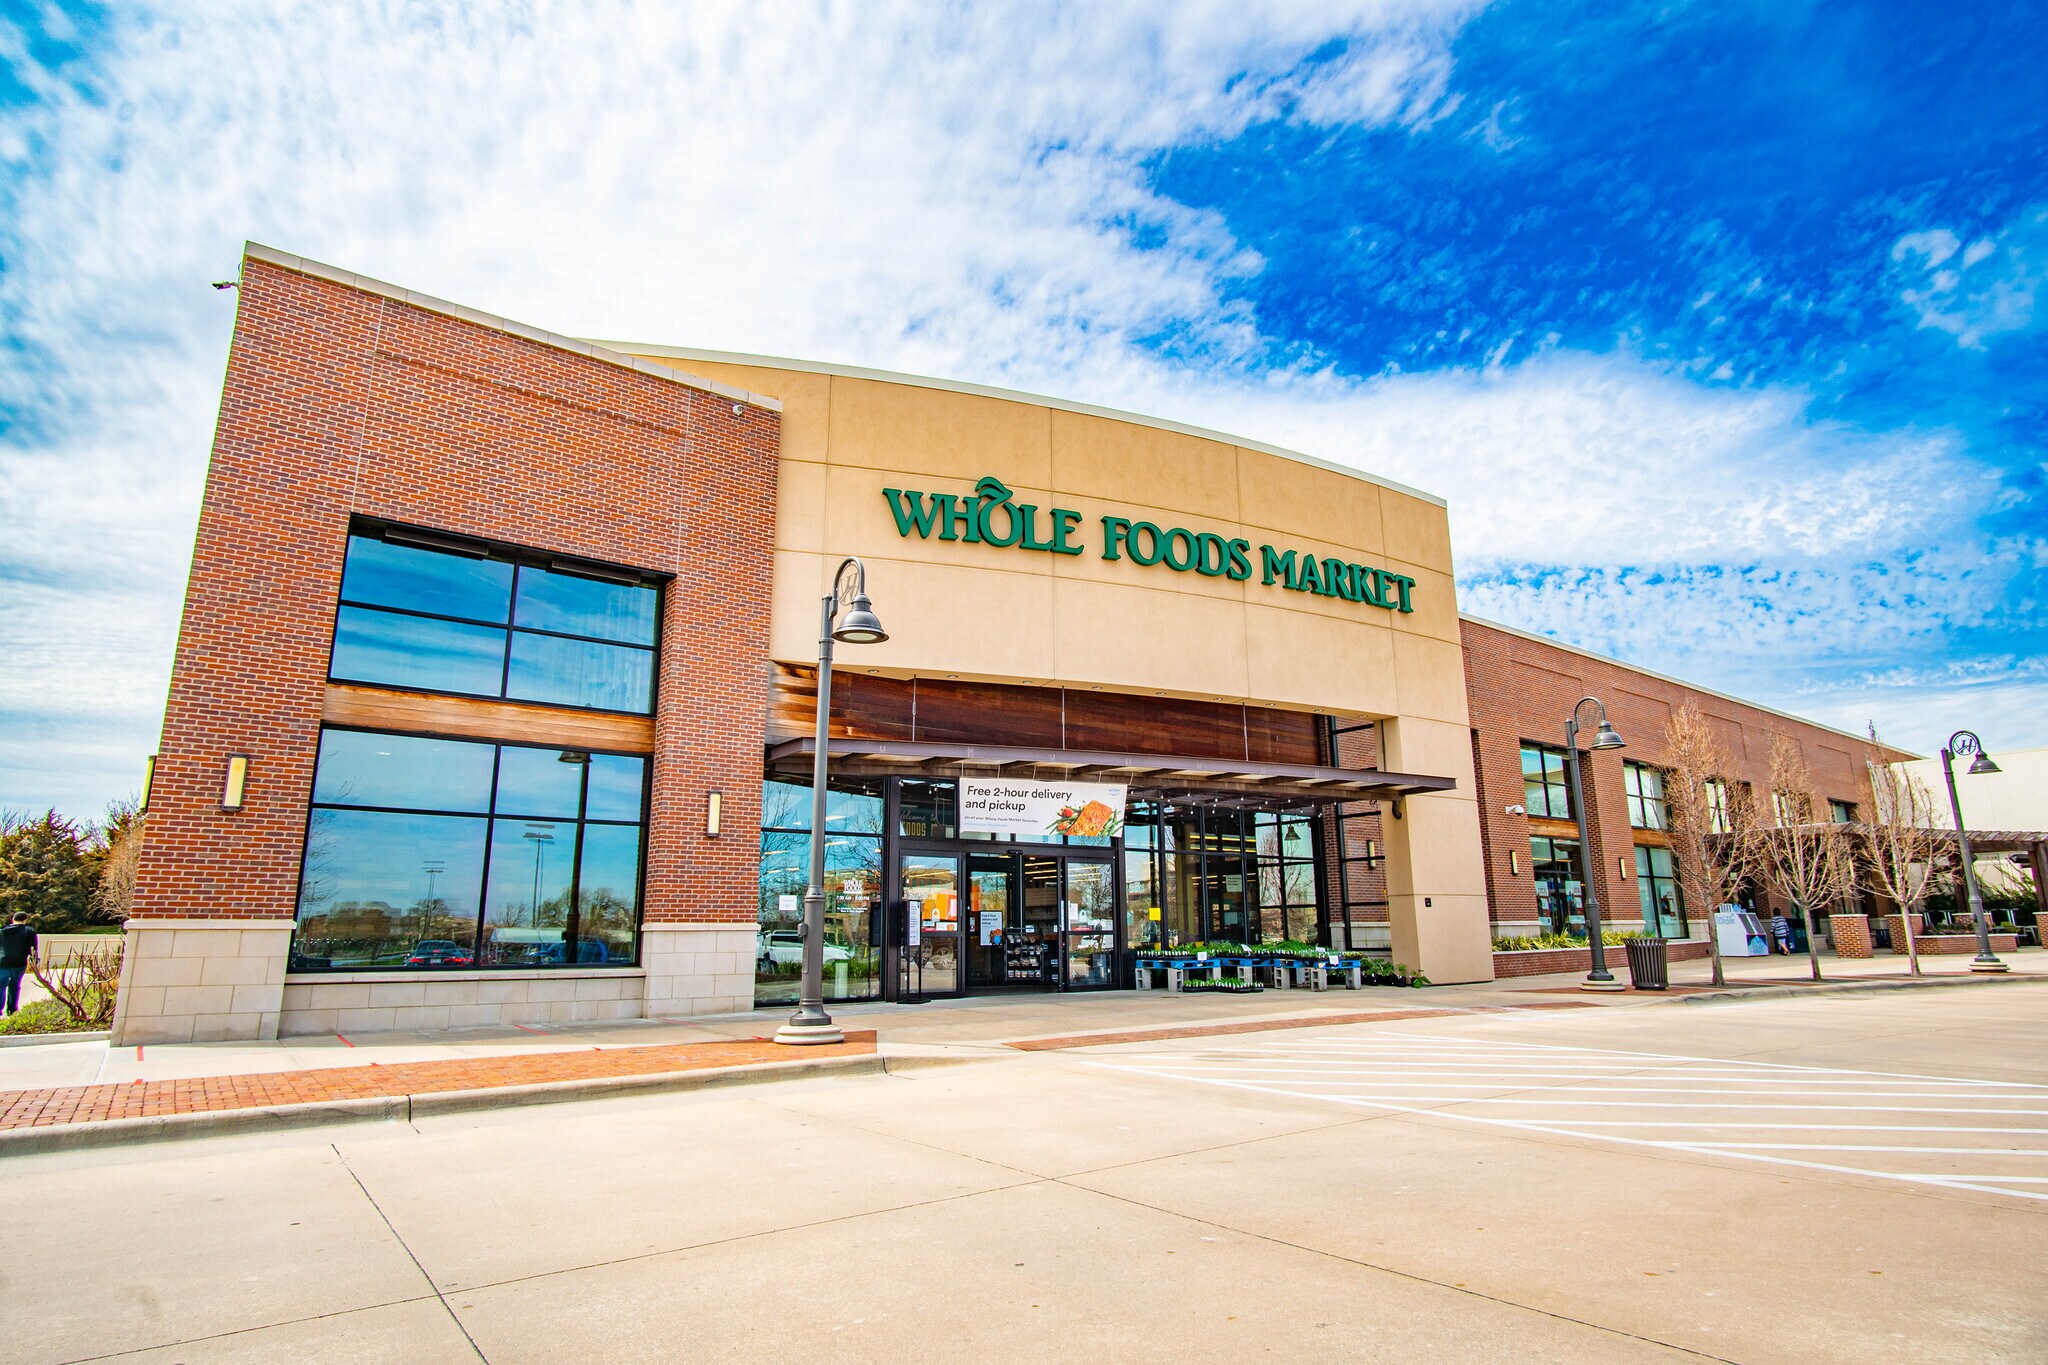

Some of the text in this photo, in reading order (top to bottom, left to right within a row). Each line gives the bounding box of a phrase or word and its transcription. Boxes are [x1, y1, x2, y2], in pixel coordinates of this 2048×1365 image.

[882, 476, 1416, 614] WHOLE FOODS MARKET
[967, 785, 1072, 802] Free 2-hour delivery
[965, 799, 1026, 812] and pickup
[843, 878, 863, 886] WHOLE
